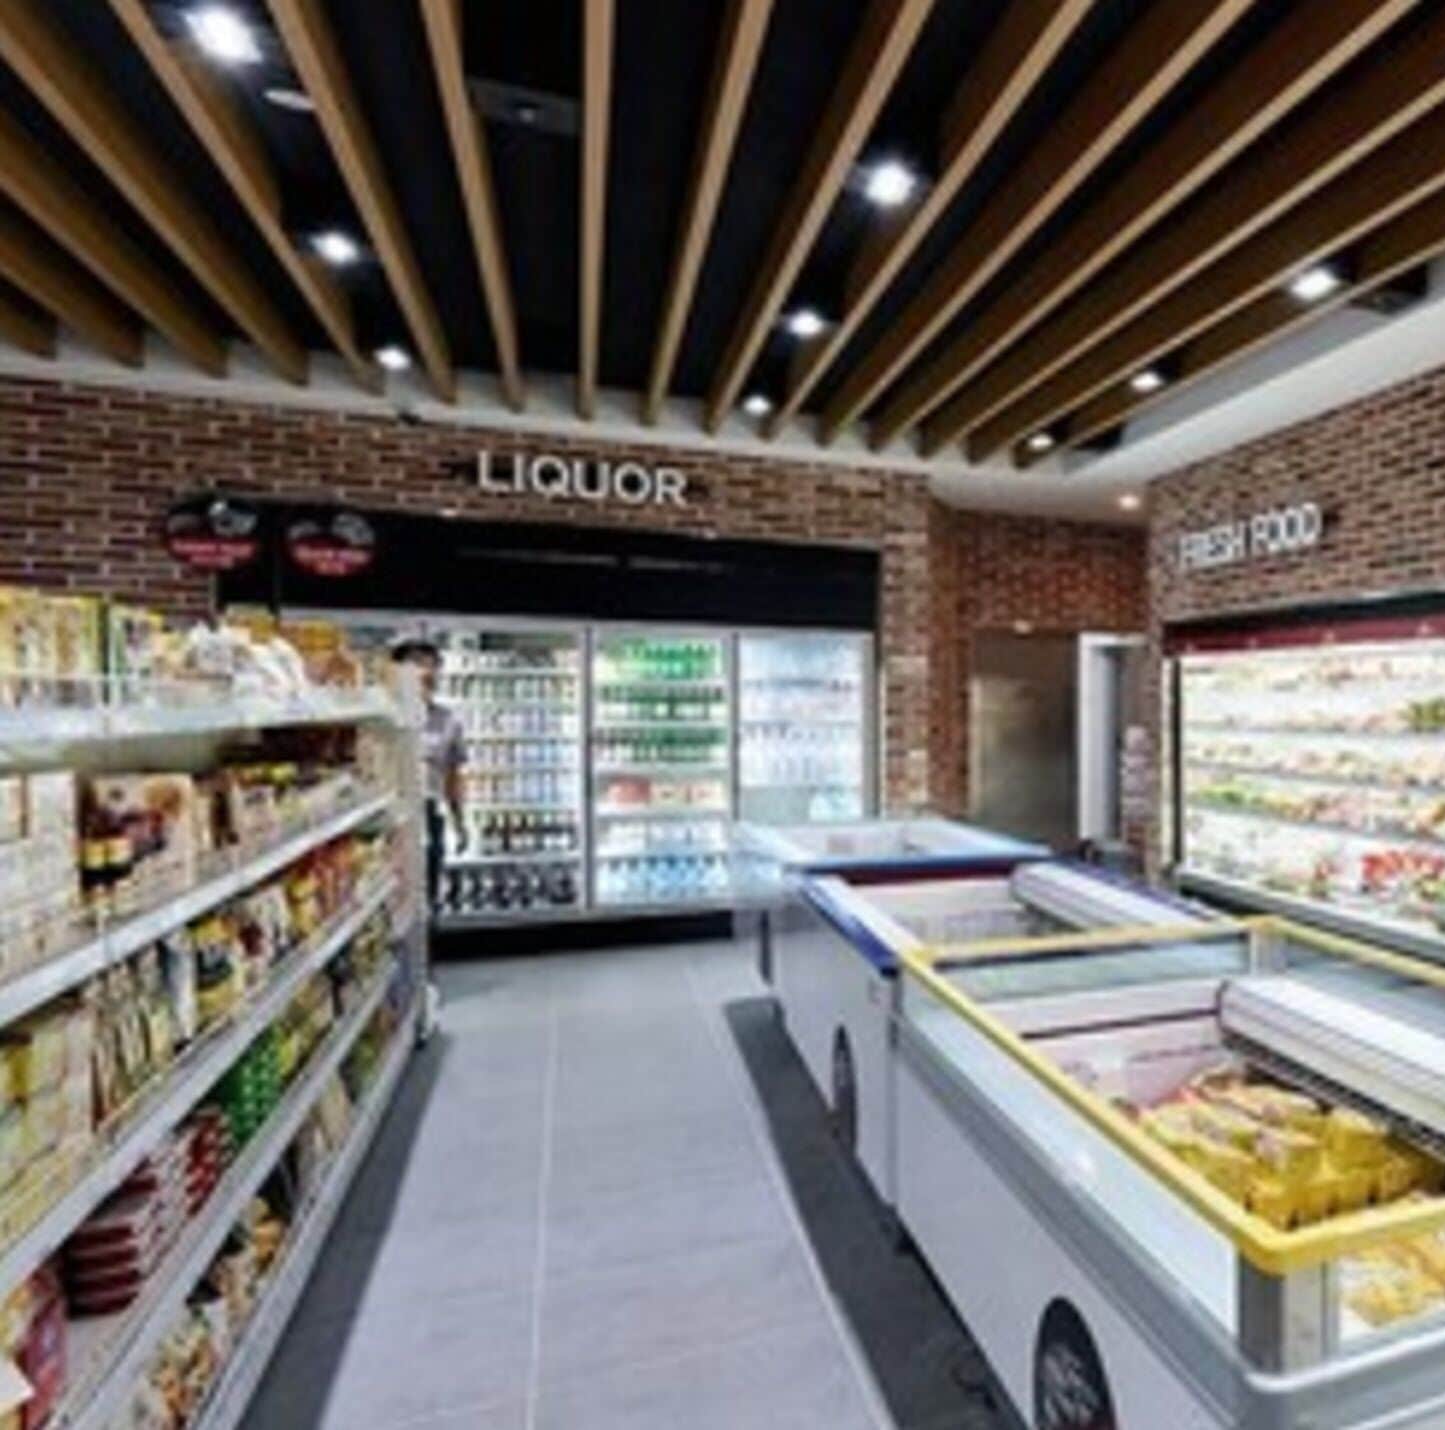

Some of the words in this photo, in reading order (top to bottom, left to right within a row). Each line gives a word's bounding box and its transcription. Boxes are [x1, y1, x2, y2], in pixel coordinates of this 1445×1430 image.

[477, 450, 689, 507] LIQUOR
[1178, 519, 1247, 573] FRESH
[1251, 502, 1322, 554] FOOD
